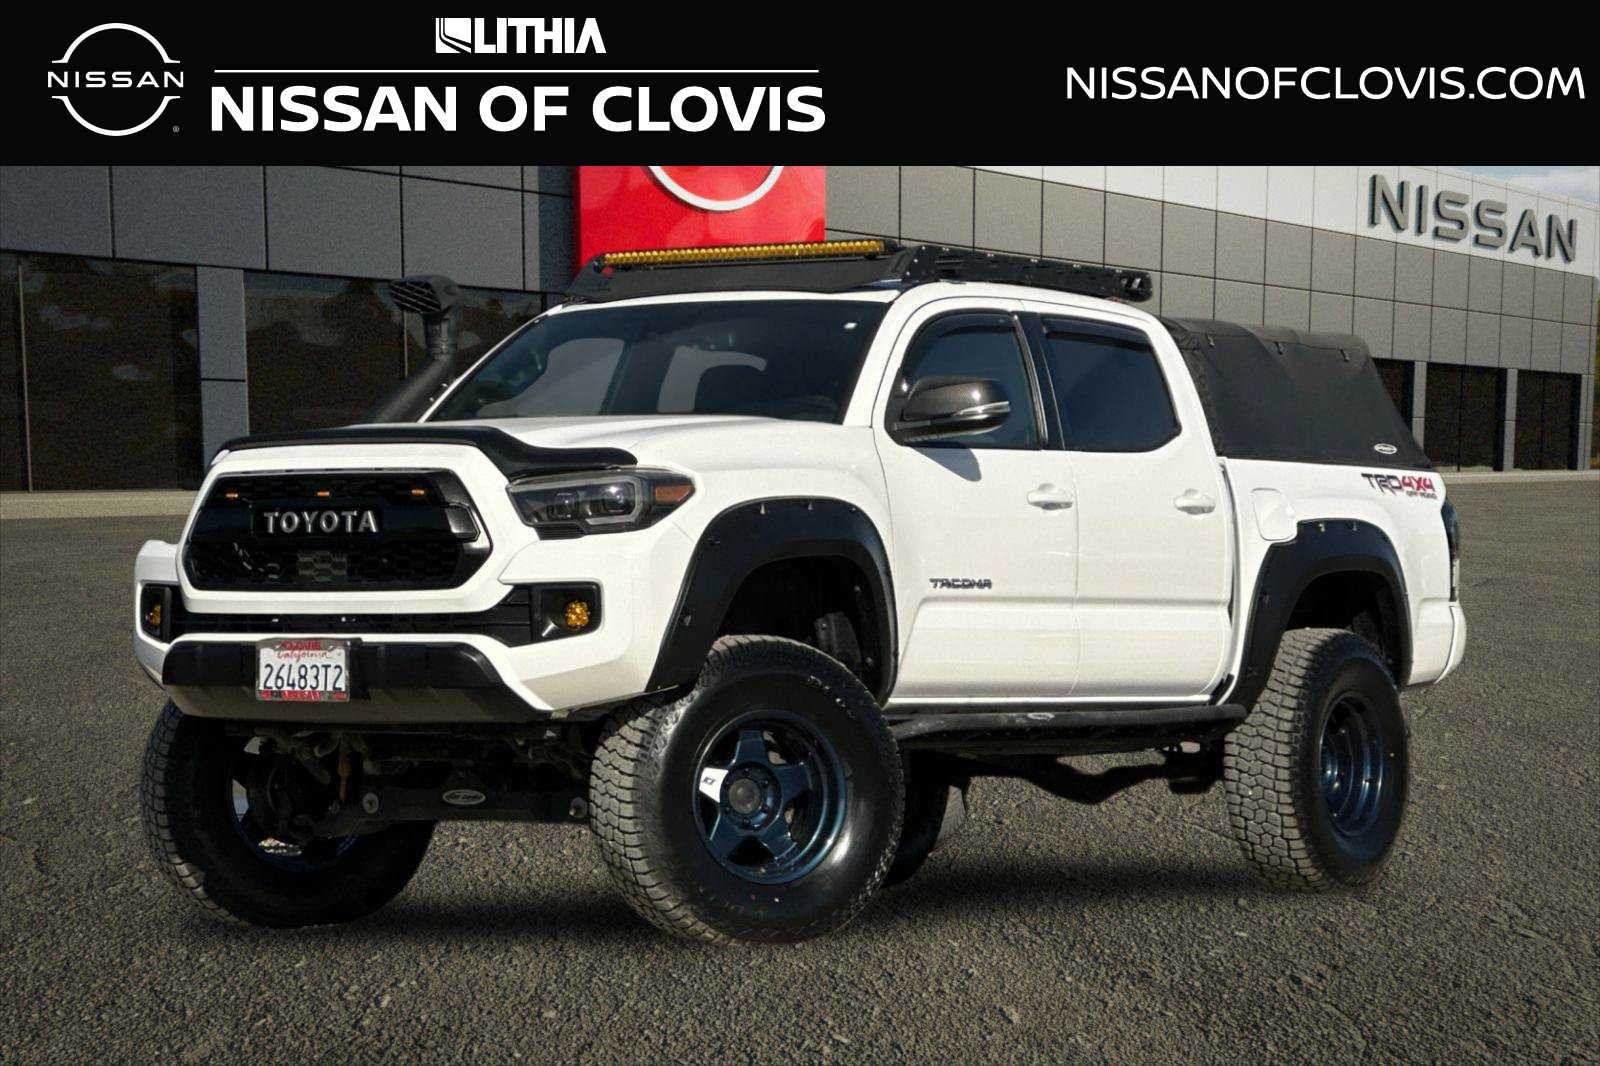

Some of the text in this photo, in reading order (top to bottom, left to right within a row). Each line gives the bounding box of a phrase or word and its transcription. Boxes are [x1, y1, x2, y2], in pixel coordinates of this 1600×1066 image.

[1368, 173, 1577, 263] NISSAN
[263, 510, 379, 533] TOYOTA
[929, 578, 992, 589] TACOMA
[263, 663, 343, 690] 26483T2
